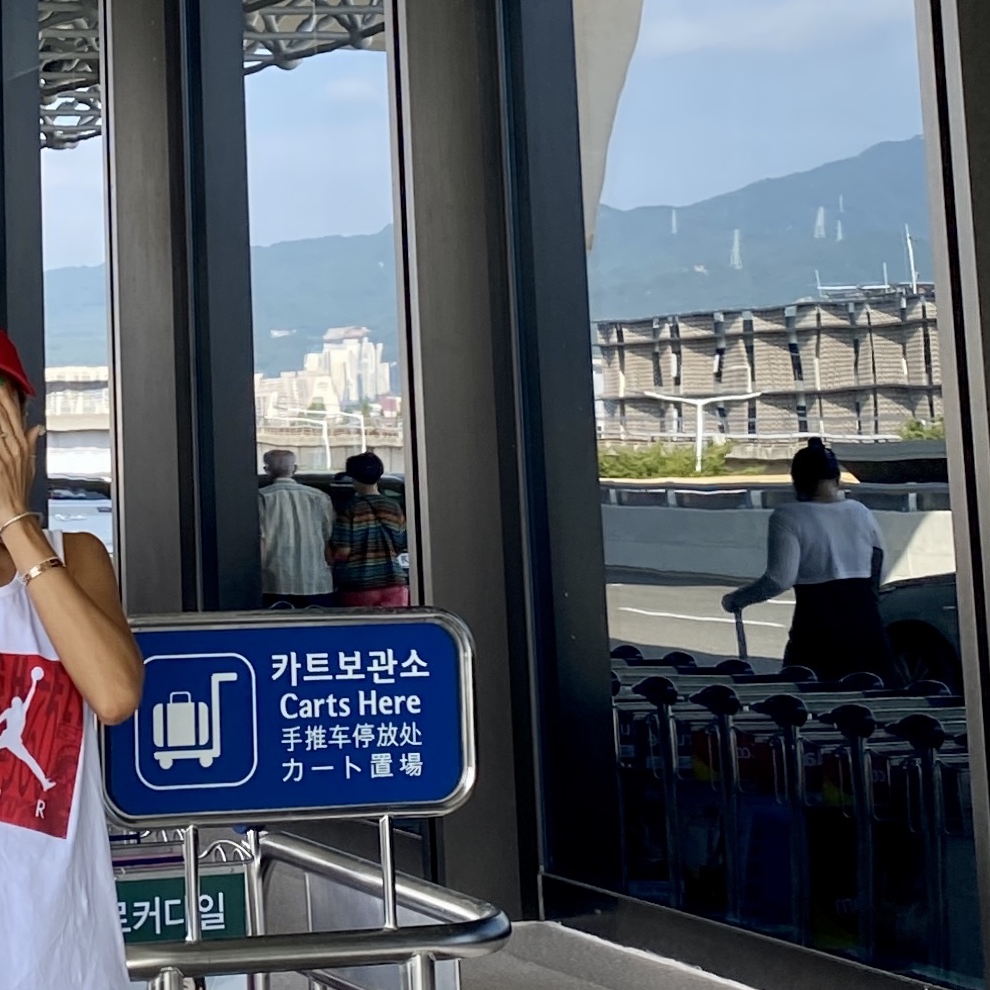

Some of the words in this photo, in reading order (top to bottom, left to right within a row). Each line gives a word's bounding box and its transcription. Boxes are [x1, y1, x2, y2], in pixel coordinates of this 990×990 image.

[271, 649, 430, 687] 카트보관소
[279, 693, 351, 719] Carts
[358, 690, 422, 716] Here
[281, 722, 423, 752] 手推车停放处
[282, 753, 423, 782] カート置場
